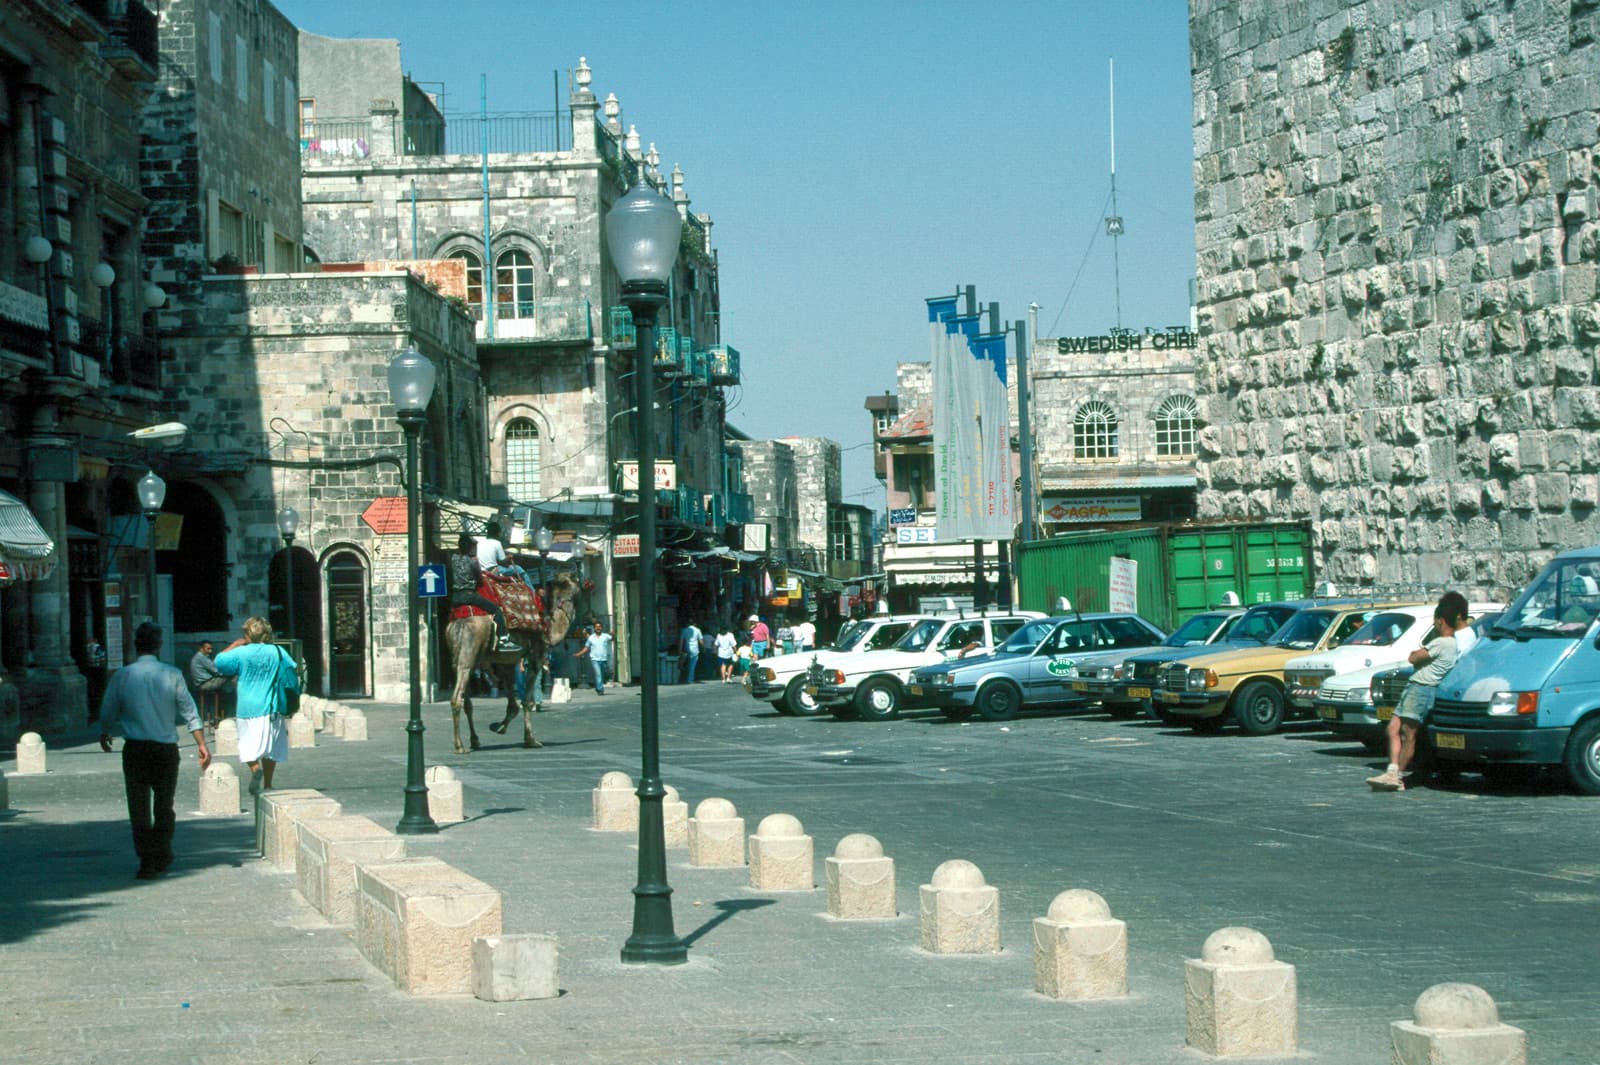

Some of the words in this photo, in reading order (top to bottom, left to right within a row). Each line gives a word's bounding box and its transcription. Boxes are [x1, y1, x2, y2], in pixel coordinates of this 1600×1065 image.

[1058, 334, 1142, 355] SWEDISH
[939, 444, 948, 473] David
[940, 490, 948, 519] Tower
[1069, 505, 1108, 519] AGFA
